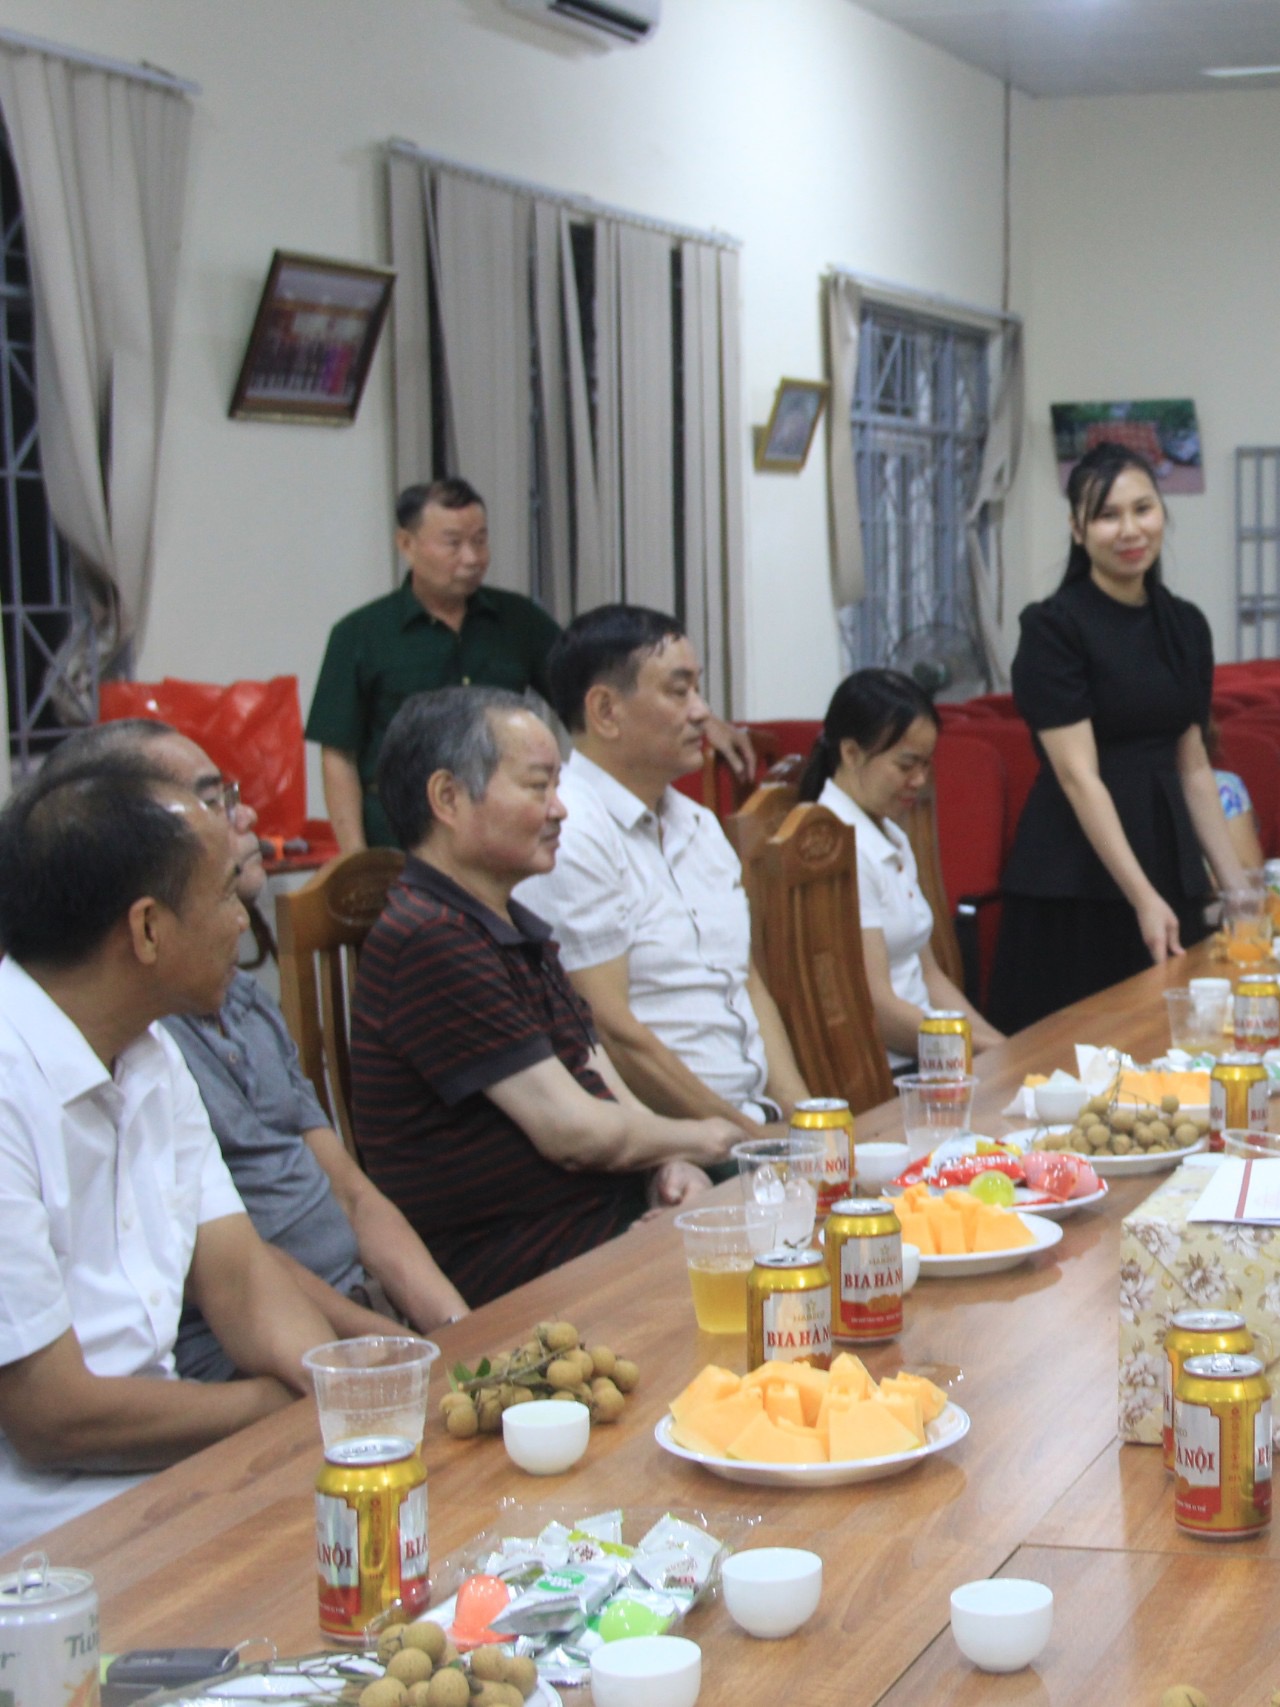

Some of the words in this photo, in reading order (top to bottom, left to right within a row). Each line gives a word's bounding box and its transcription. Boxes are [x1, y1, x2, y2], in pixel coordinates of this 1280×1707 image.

[844, 1272, 871, 1289] BIA
[874, 1267, 895, 1287] HÀ
[767, 1331, 796, 1348] BIA
[800, 1324, 821, 1346] HÀ
[1182, 1445, 1215, 1473] NỘI
